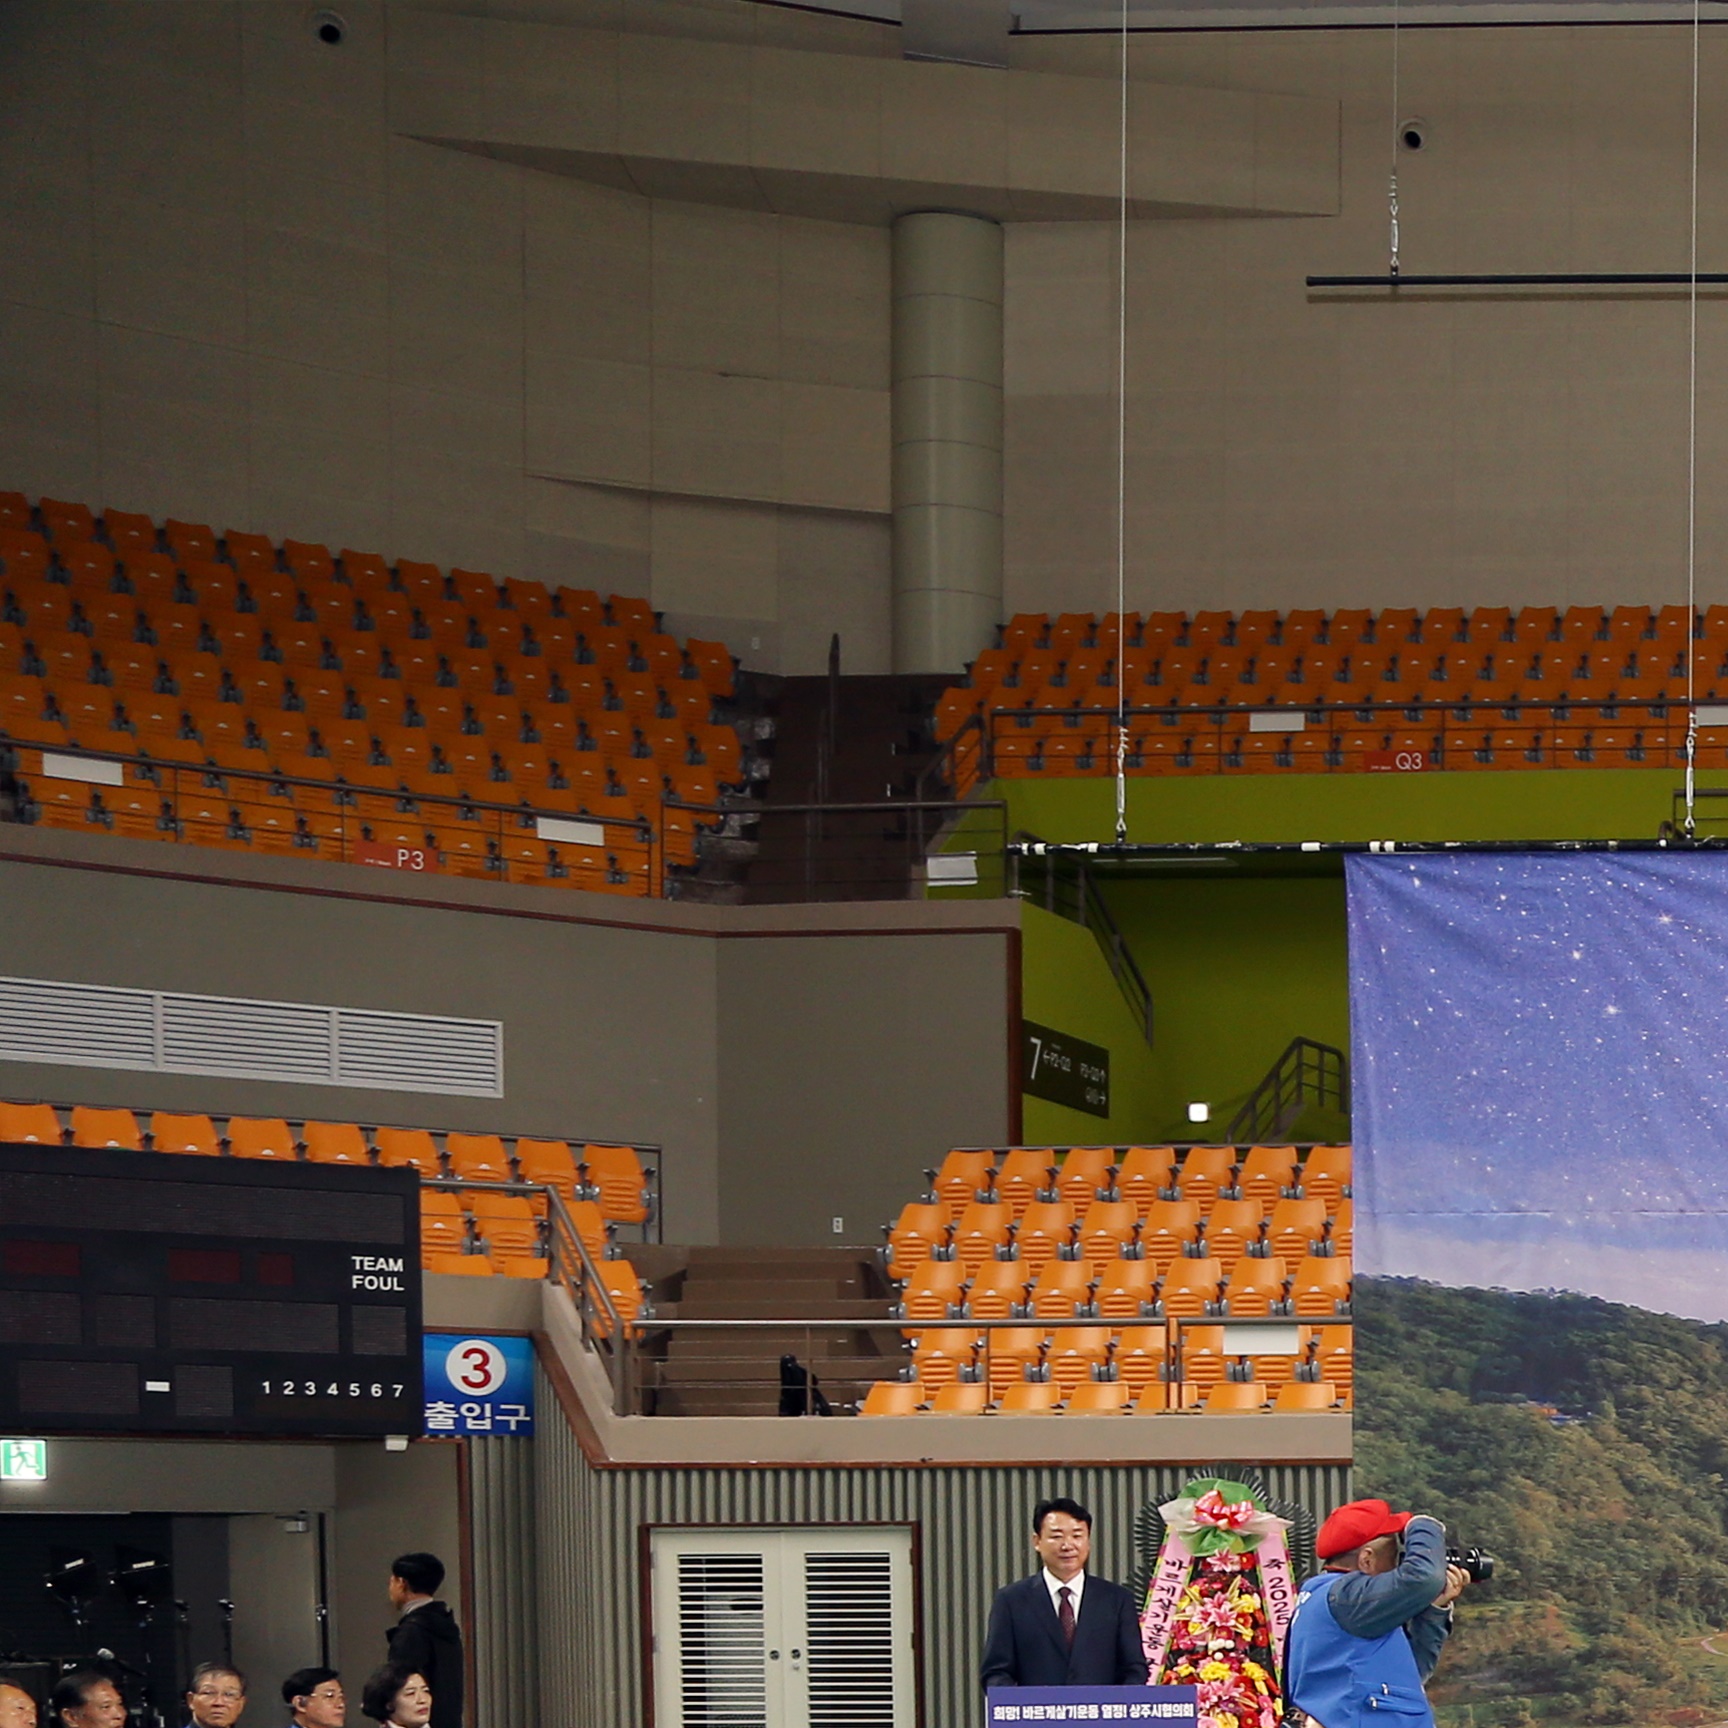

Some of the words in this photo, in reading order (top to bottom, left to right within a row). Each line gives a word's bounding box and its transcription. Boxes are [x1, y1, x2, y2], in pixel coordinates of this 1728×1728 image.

[1396, 752, 1422, 770] Q3
[397, 848, 424, 870] P3
[1029, 1036, 1042, 1080] 7
[352, 1255, 404, 1273] TEAM
[352, 1274, 405, 1292] FOUL
[461, 1348, 491, 1388] 3
[262, 1381, 270, 1398] 1
[283, 1381, 295, 1398] 2
[304, 1381, 316, 1398] 3
[327, 1381, 339, 1398] 4
[349, 1381, 361, 1398] 5
[371, 1381, 382, 1398] 6
[392, 1381, 404, 1398] 7
[424, 1401, 531, 1431] 출입구
[1269, 1577, 1290, 1625] 2025
[993, 1705, 1021, 1721] 희망!
[1022, 1704, 1099, 1720] 바르게살기운동
[1101, 1703, 1128, 1719] 열정!
[1129, 1703, 1194, 1718] 상주시협의회
